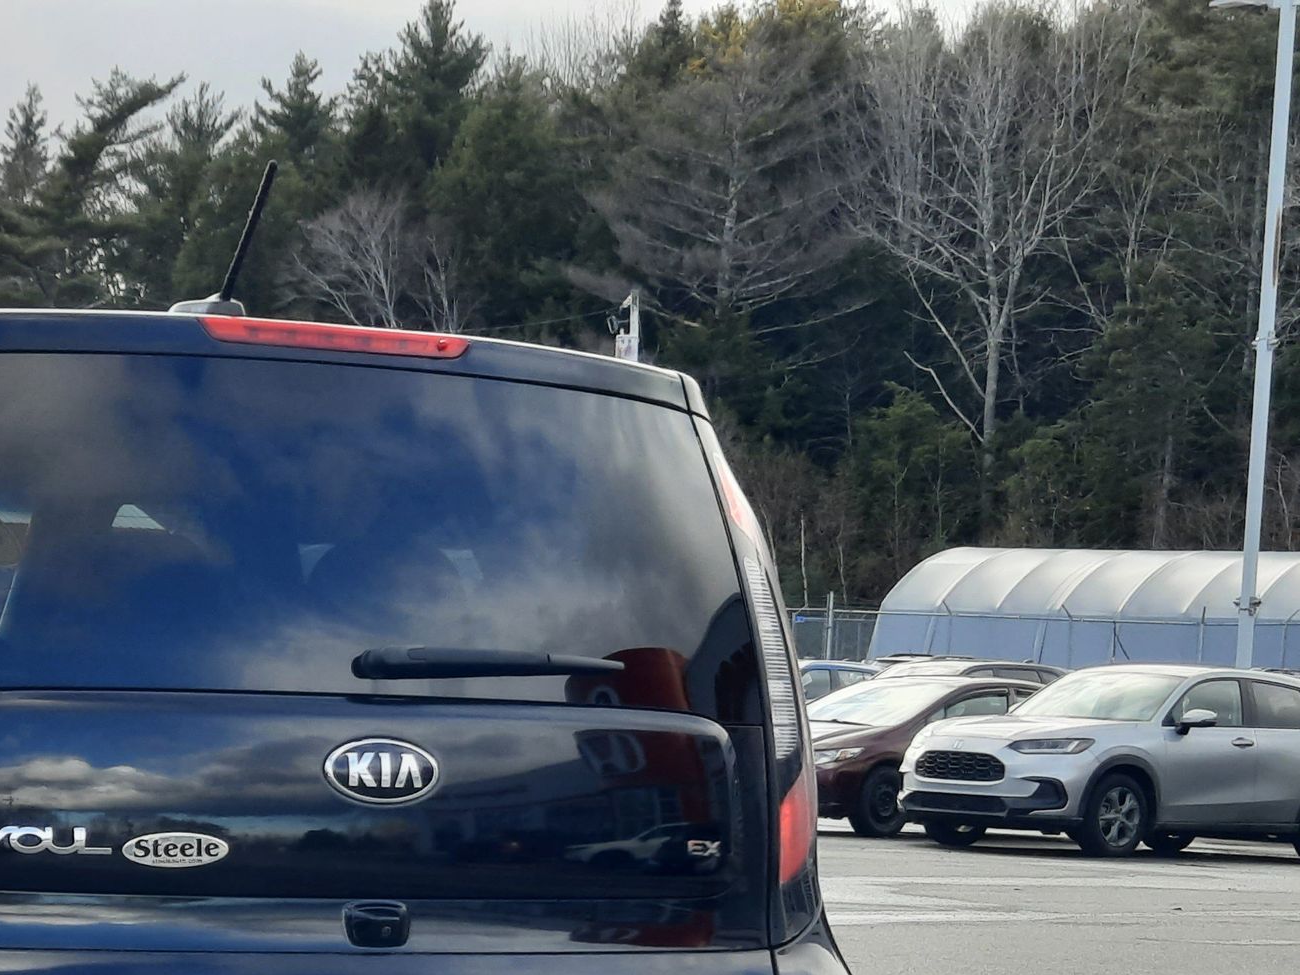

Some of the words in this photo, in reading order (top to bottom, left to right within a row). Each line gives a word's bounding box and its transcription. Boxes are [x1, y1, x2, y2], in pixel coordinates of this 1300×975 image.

[344, 751, 423, 788] KIA
[133, 838, 220, 858] Steele
[687, 839, 721, 857] EX
